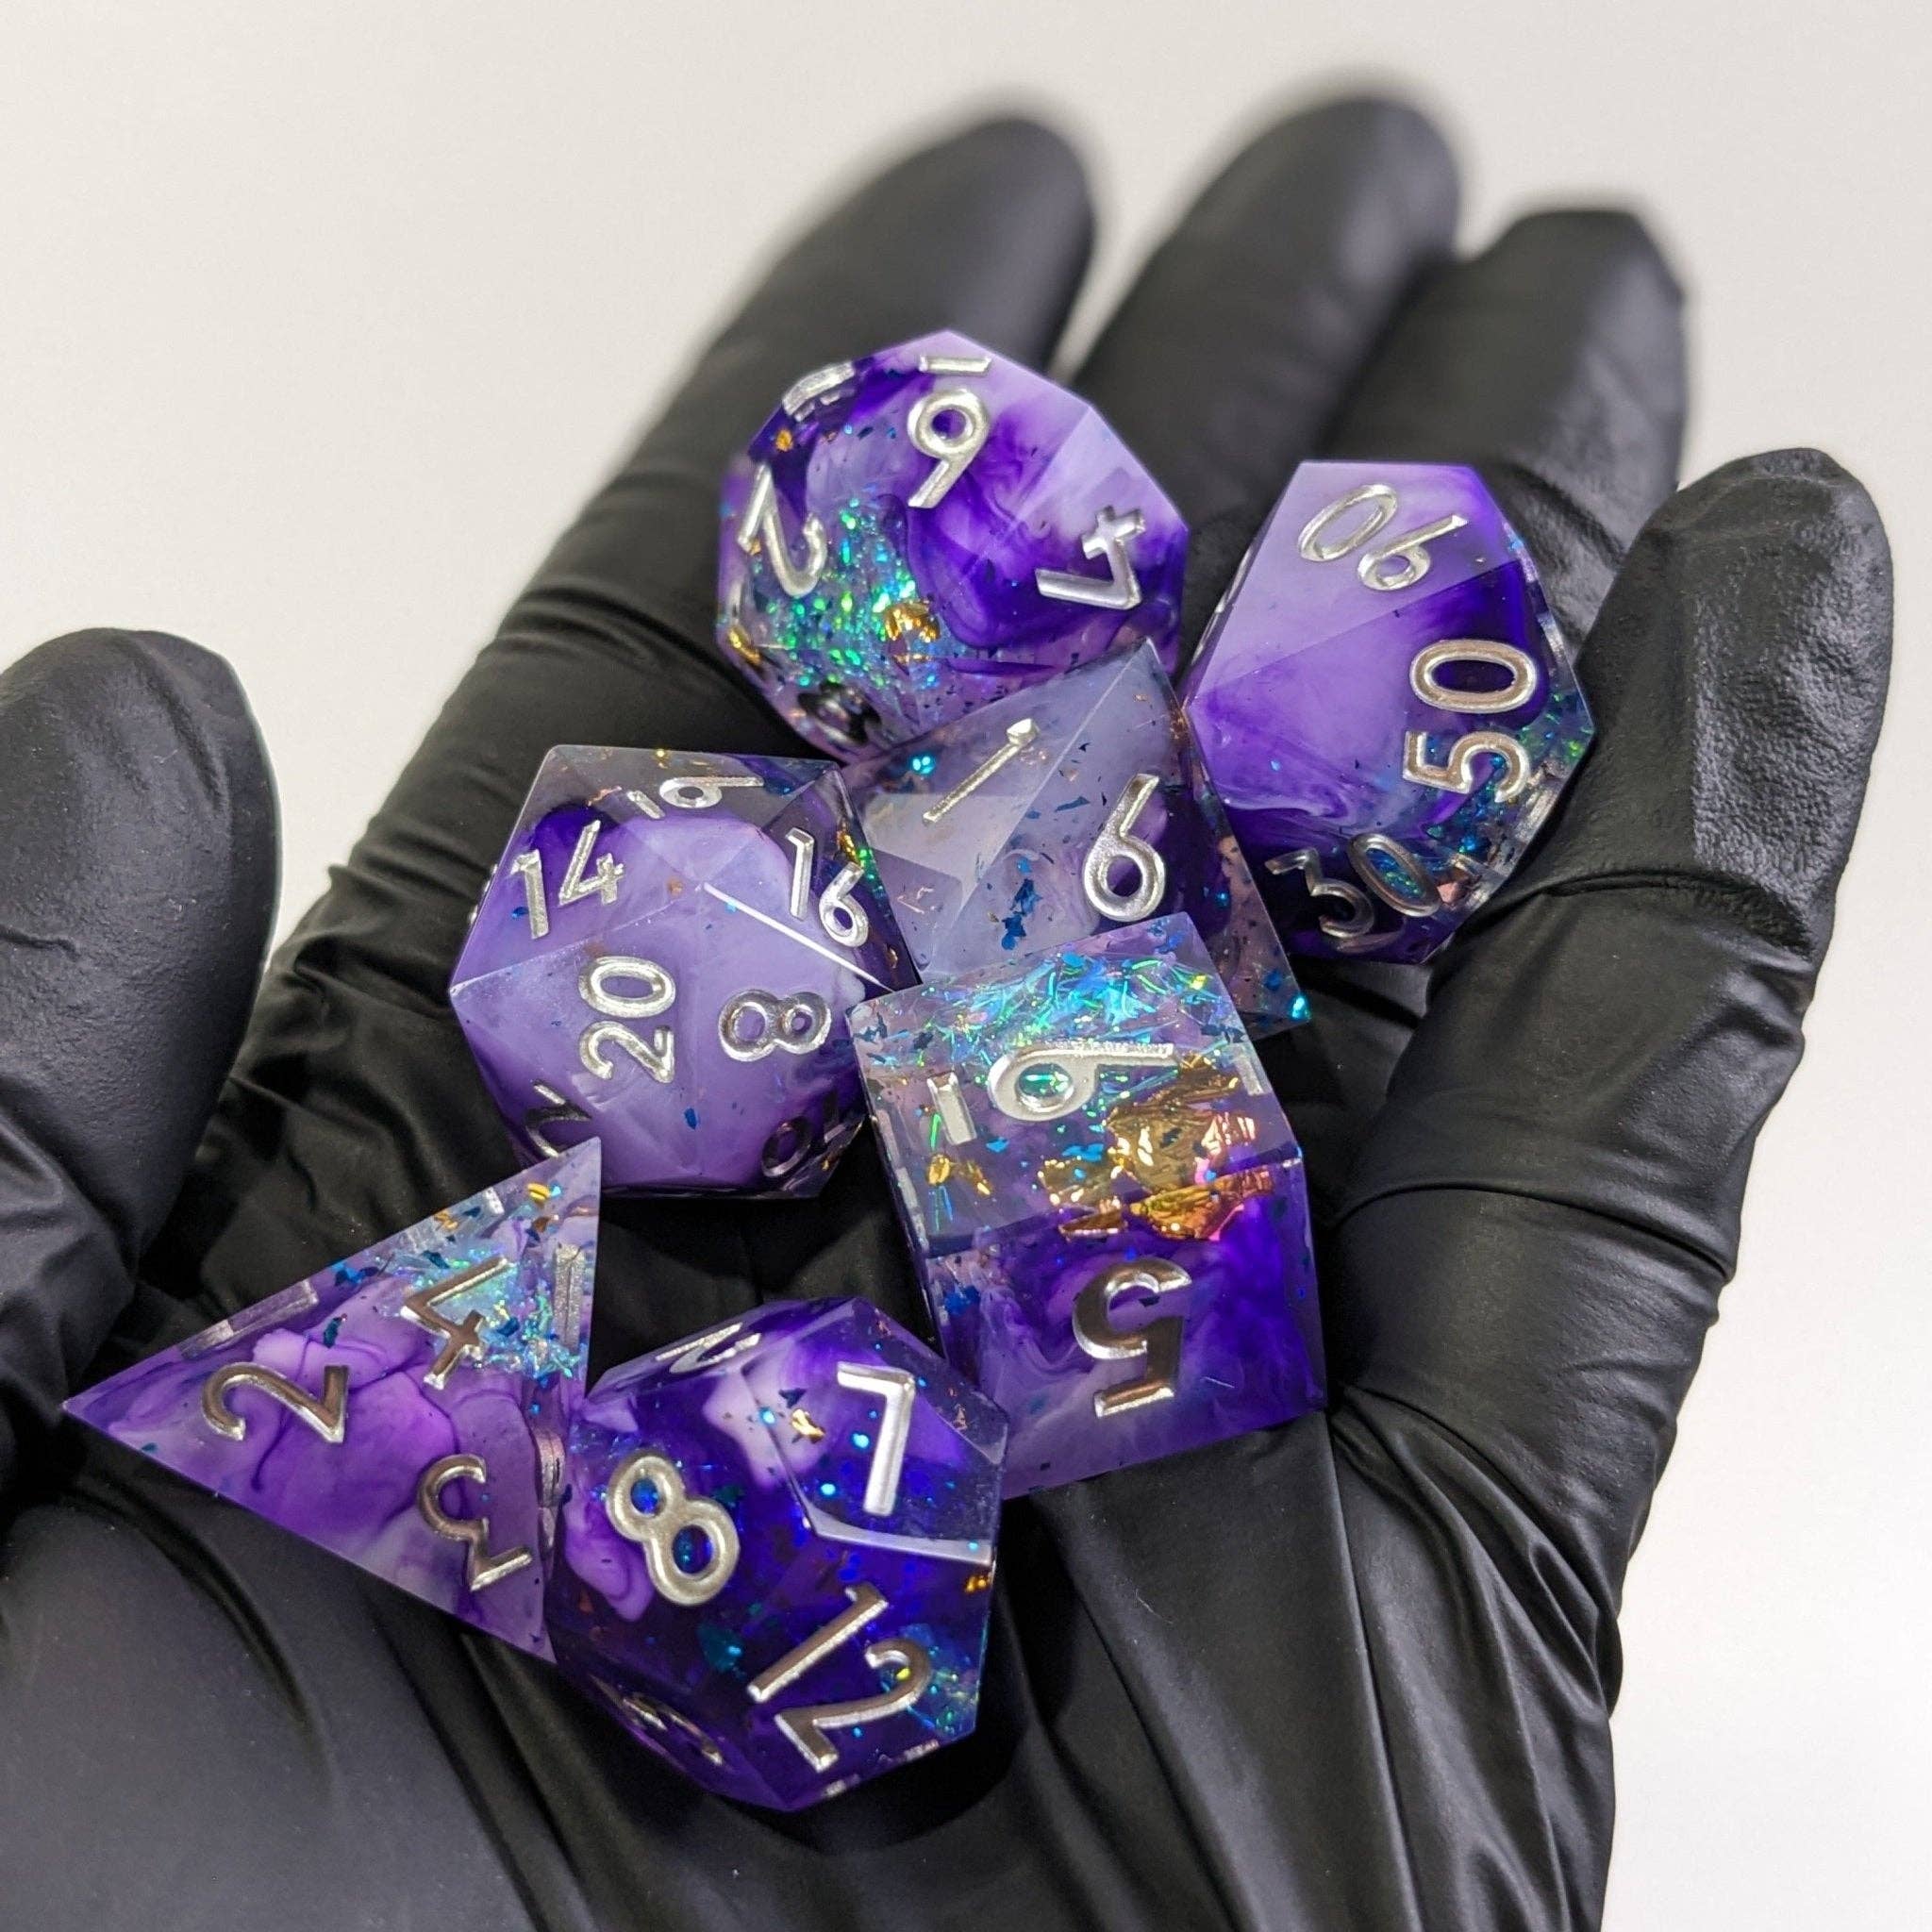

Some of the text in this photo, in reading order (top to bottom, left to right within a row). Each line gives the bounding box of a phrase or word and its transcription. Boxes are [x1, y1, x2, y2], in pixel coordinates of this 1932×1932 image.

[737, 463, 827, 596] 2
[1035, 505, 1147, 610] 4
[922, 717, 1040, 824] 1
[1402, 638, 1539, 803] 50
[509, 819, 625, 940] 14
[785, 826, 870, 947] 16
[1083, 773, 1167, 923] 6
[1264, 832, 1441, 939] 30
[577, 954, 677, 1084] 20
[717, 989, 832, 1063] 8
[400, 1256, 517, 1391] 4
[1071, 1257, 1192, 1418] 5
[200, 1361, 350, 1444] 2
[836, 1360, 917, 1518] 7
[416, 1454, 533, 1592] 3
[605, 1452, 741, 1607] 8
[746, 1582, 933, 1774] 12
